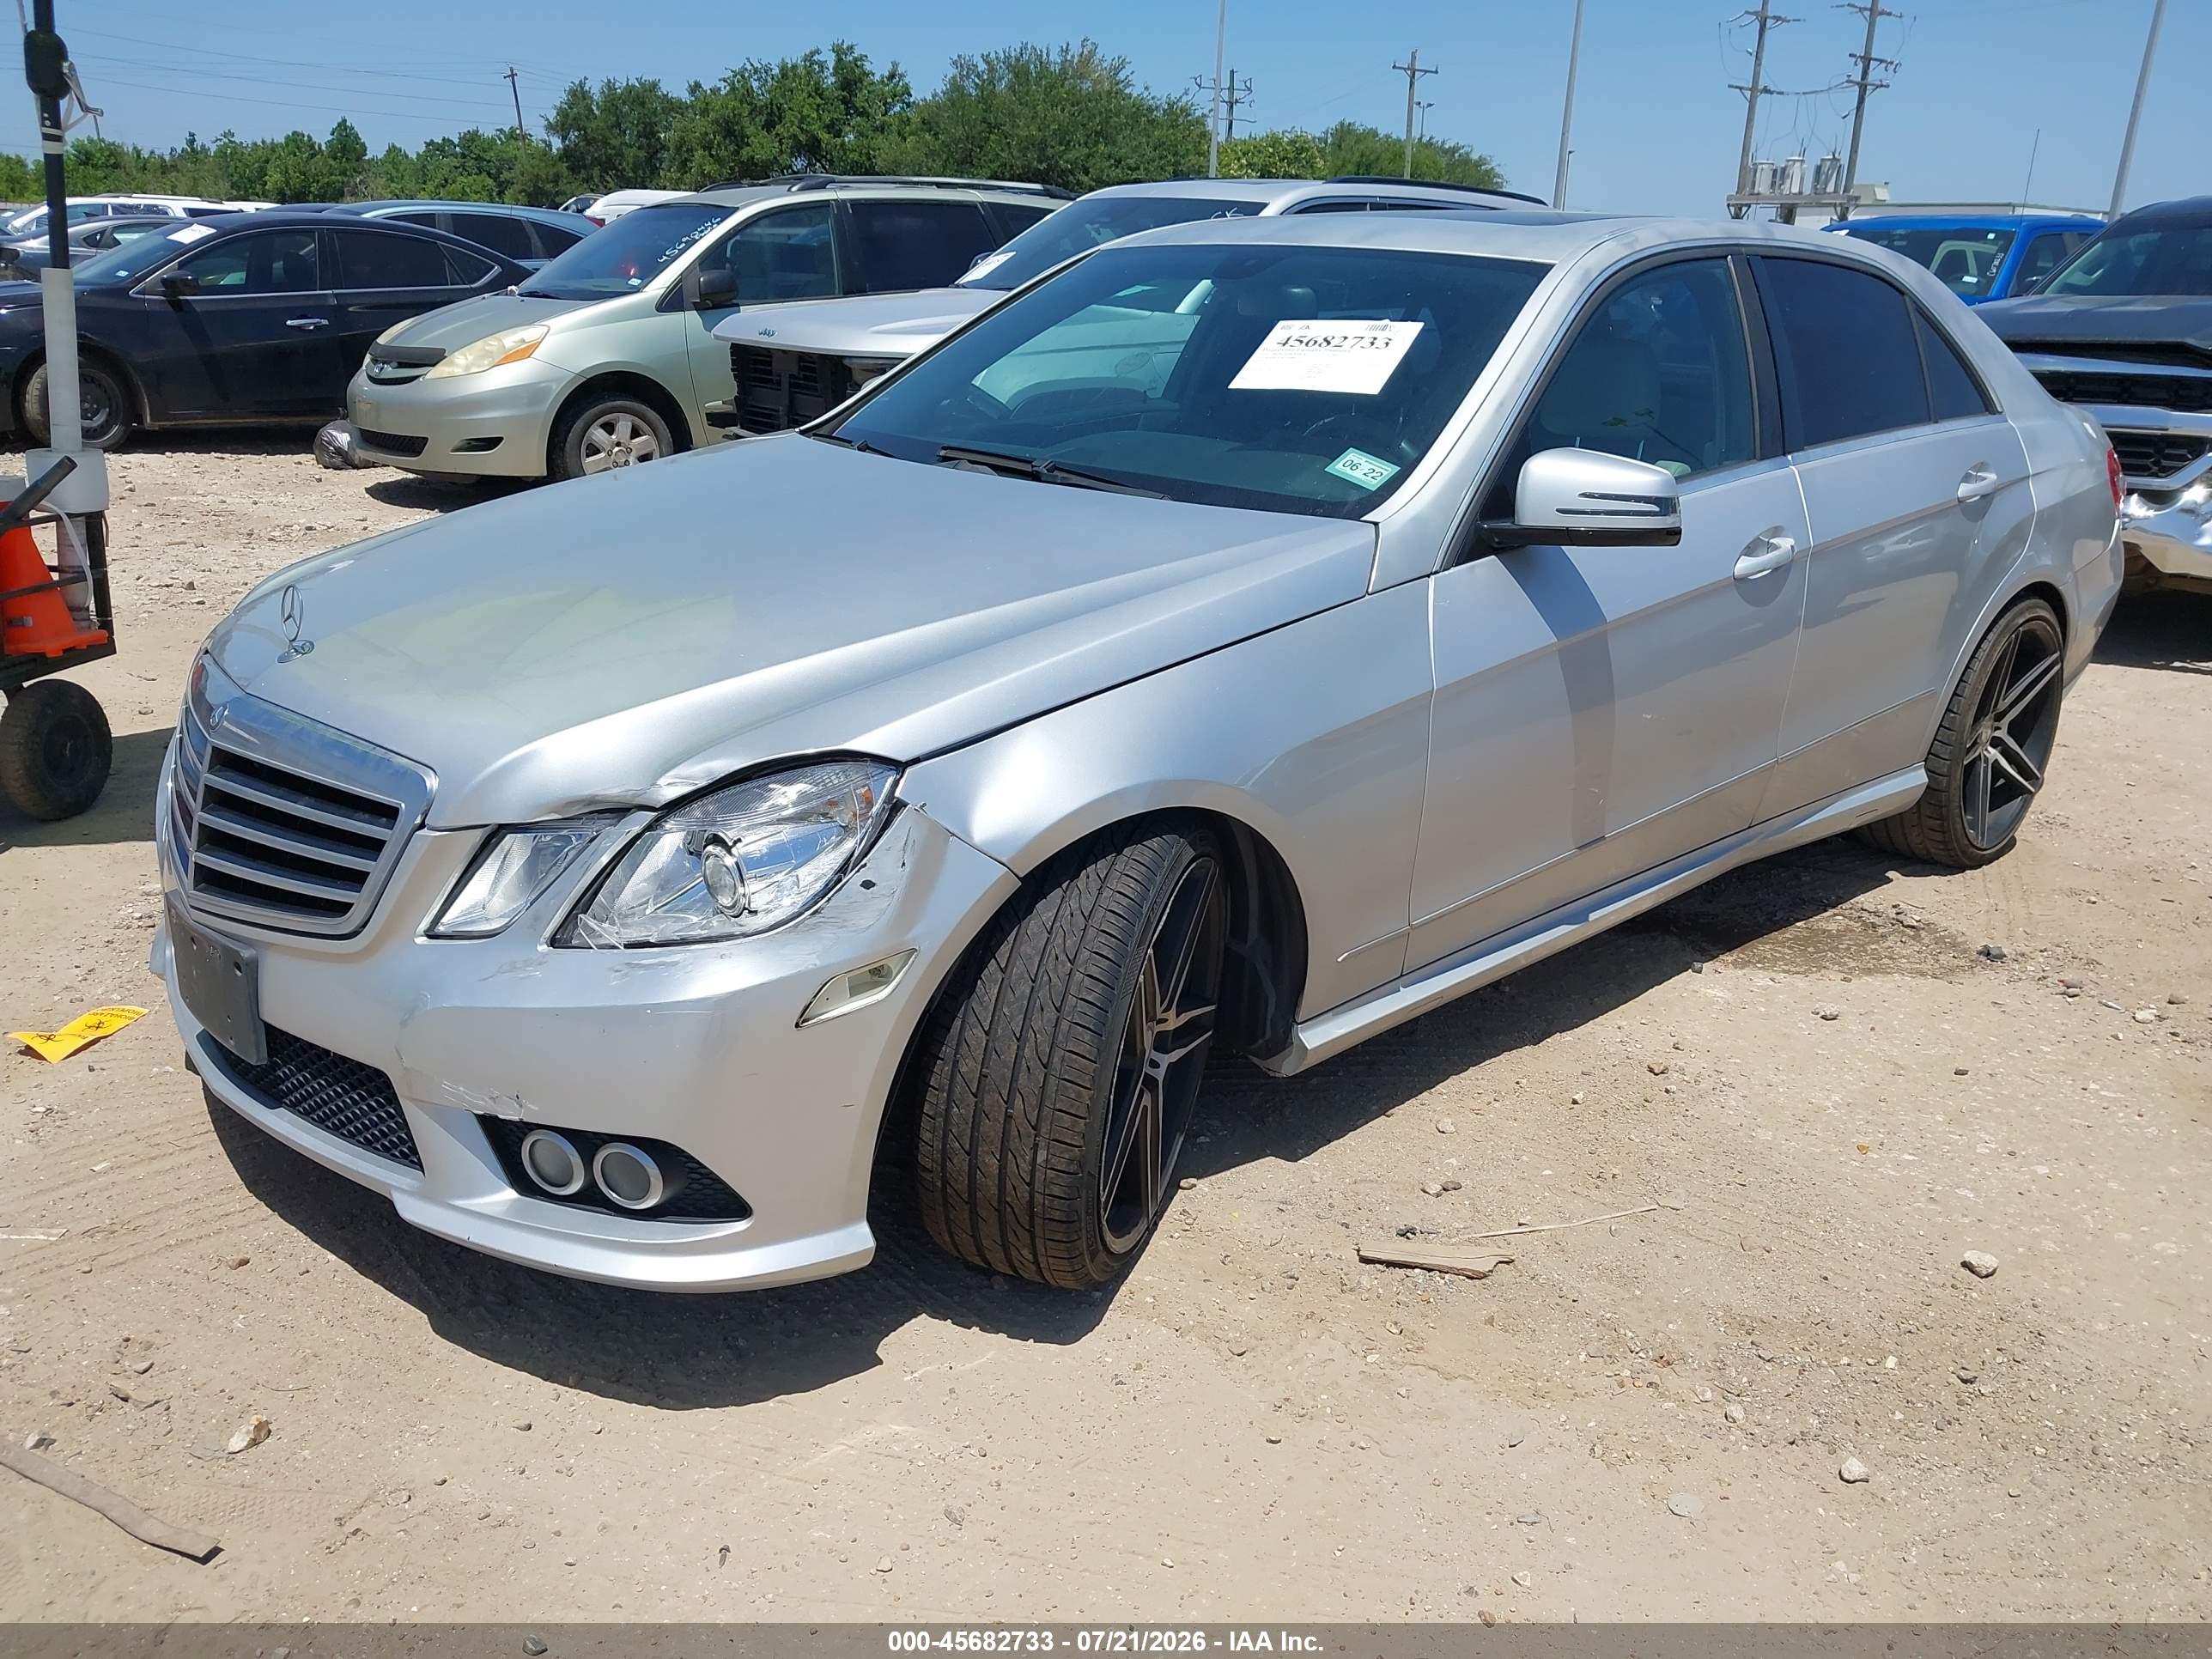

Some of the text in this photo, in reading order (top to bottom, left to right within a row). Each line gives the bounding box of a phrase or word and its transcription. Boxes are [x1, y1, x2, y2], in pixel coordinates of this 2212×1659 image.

[1276, 334, 1393, 349] 45682733
[1342, 459, 1362, 471] 06
[1363, 468, 1383, 481] 22
